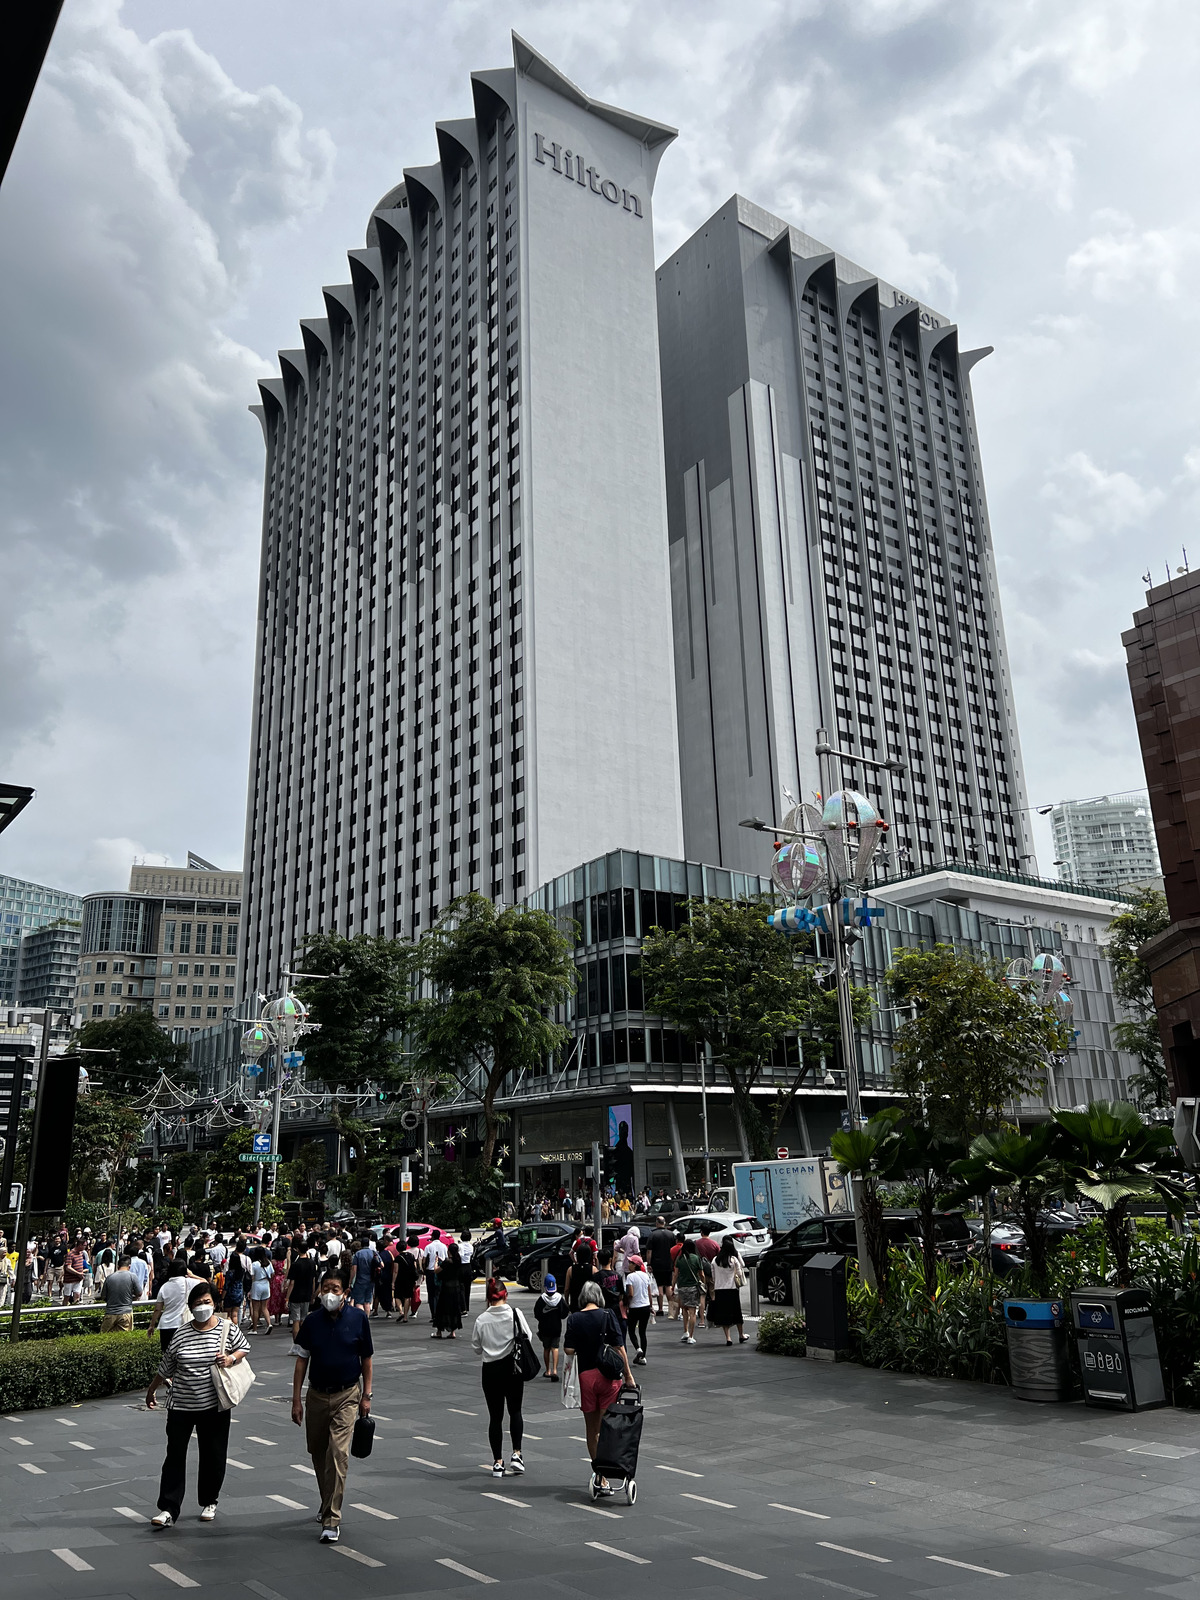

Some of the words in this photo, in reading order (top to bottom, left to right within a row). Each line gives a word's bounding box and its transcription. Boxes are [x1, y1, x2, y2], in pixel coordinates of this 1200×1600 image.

[534, 132, 643, 219] Hilton
[567, 1152, 583, 1161] KORS
[774, 1166, 814, 1174] ICEMAN
